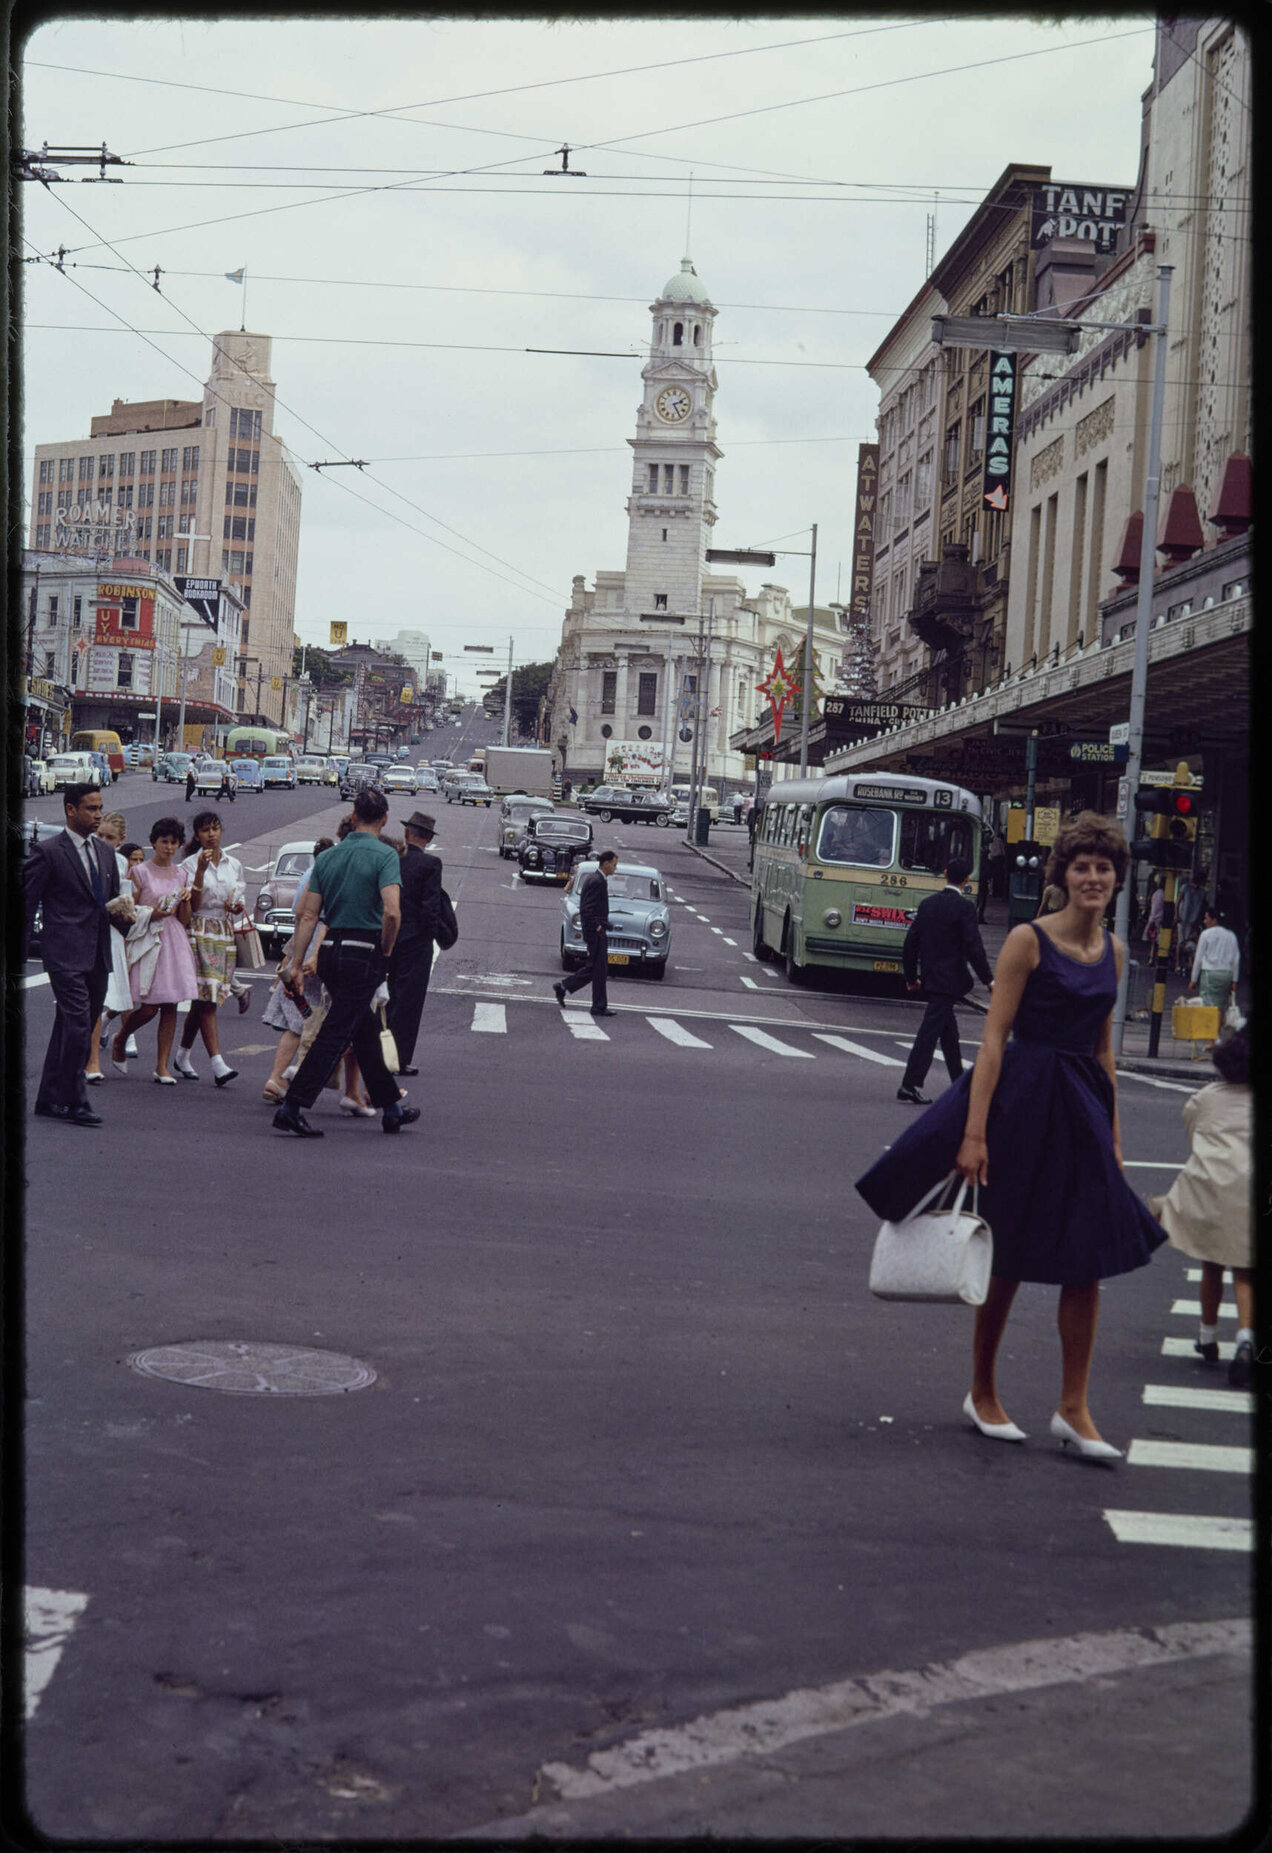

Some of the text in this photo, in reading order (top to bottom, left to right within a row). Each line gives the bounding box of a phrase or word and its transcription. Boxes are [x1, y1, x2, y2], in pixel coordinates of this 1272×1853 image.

[1041, 184, 1133, 217] TANF
[988, 350, 1014, 474] AMERAS
[55, 500, 137, 530] ROAMER
[55, 531, 138, 552] WATCHES
[853, 454, 877, 612] ATWATERS
[334, 630, 343, 639] U
[826, 701, 941, 720] 287 TANFIELD POTT
[1081, 743, 1115, 755] POLICE
[1081, 753, 1115, 761] STATION
[857, 785, 894, 800] ROSEBANK
[935, 791, 952, 805] 13
